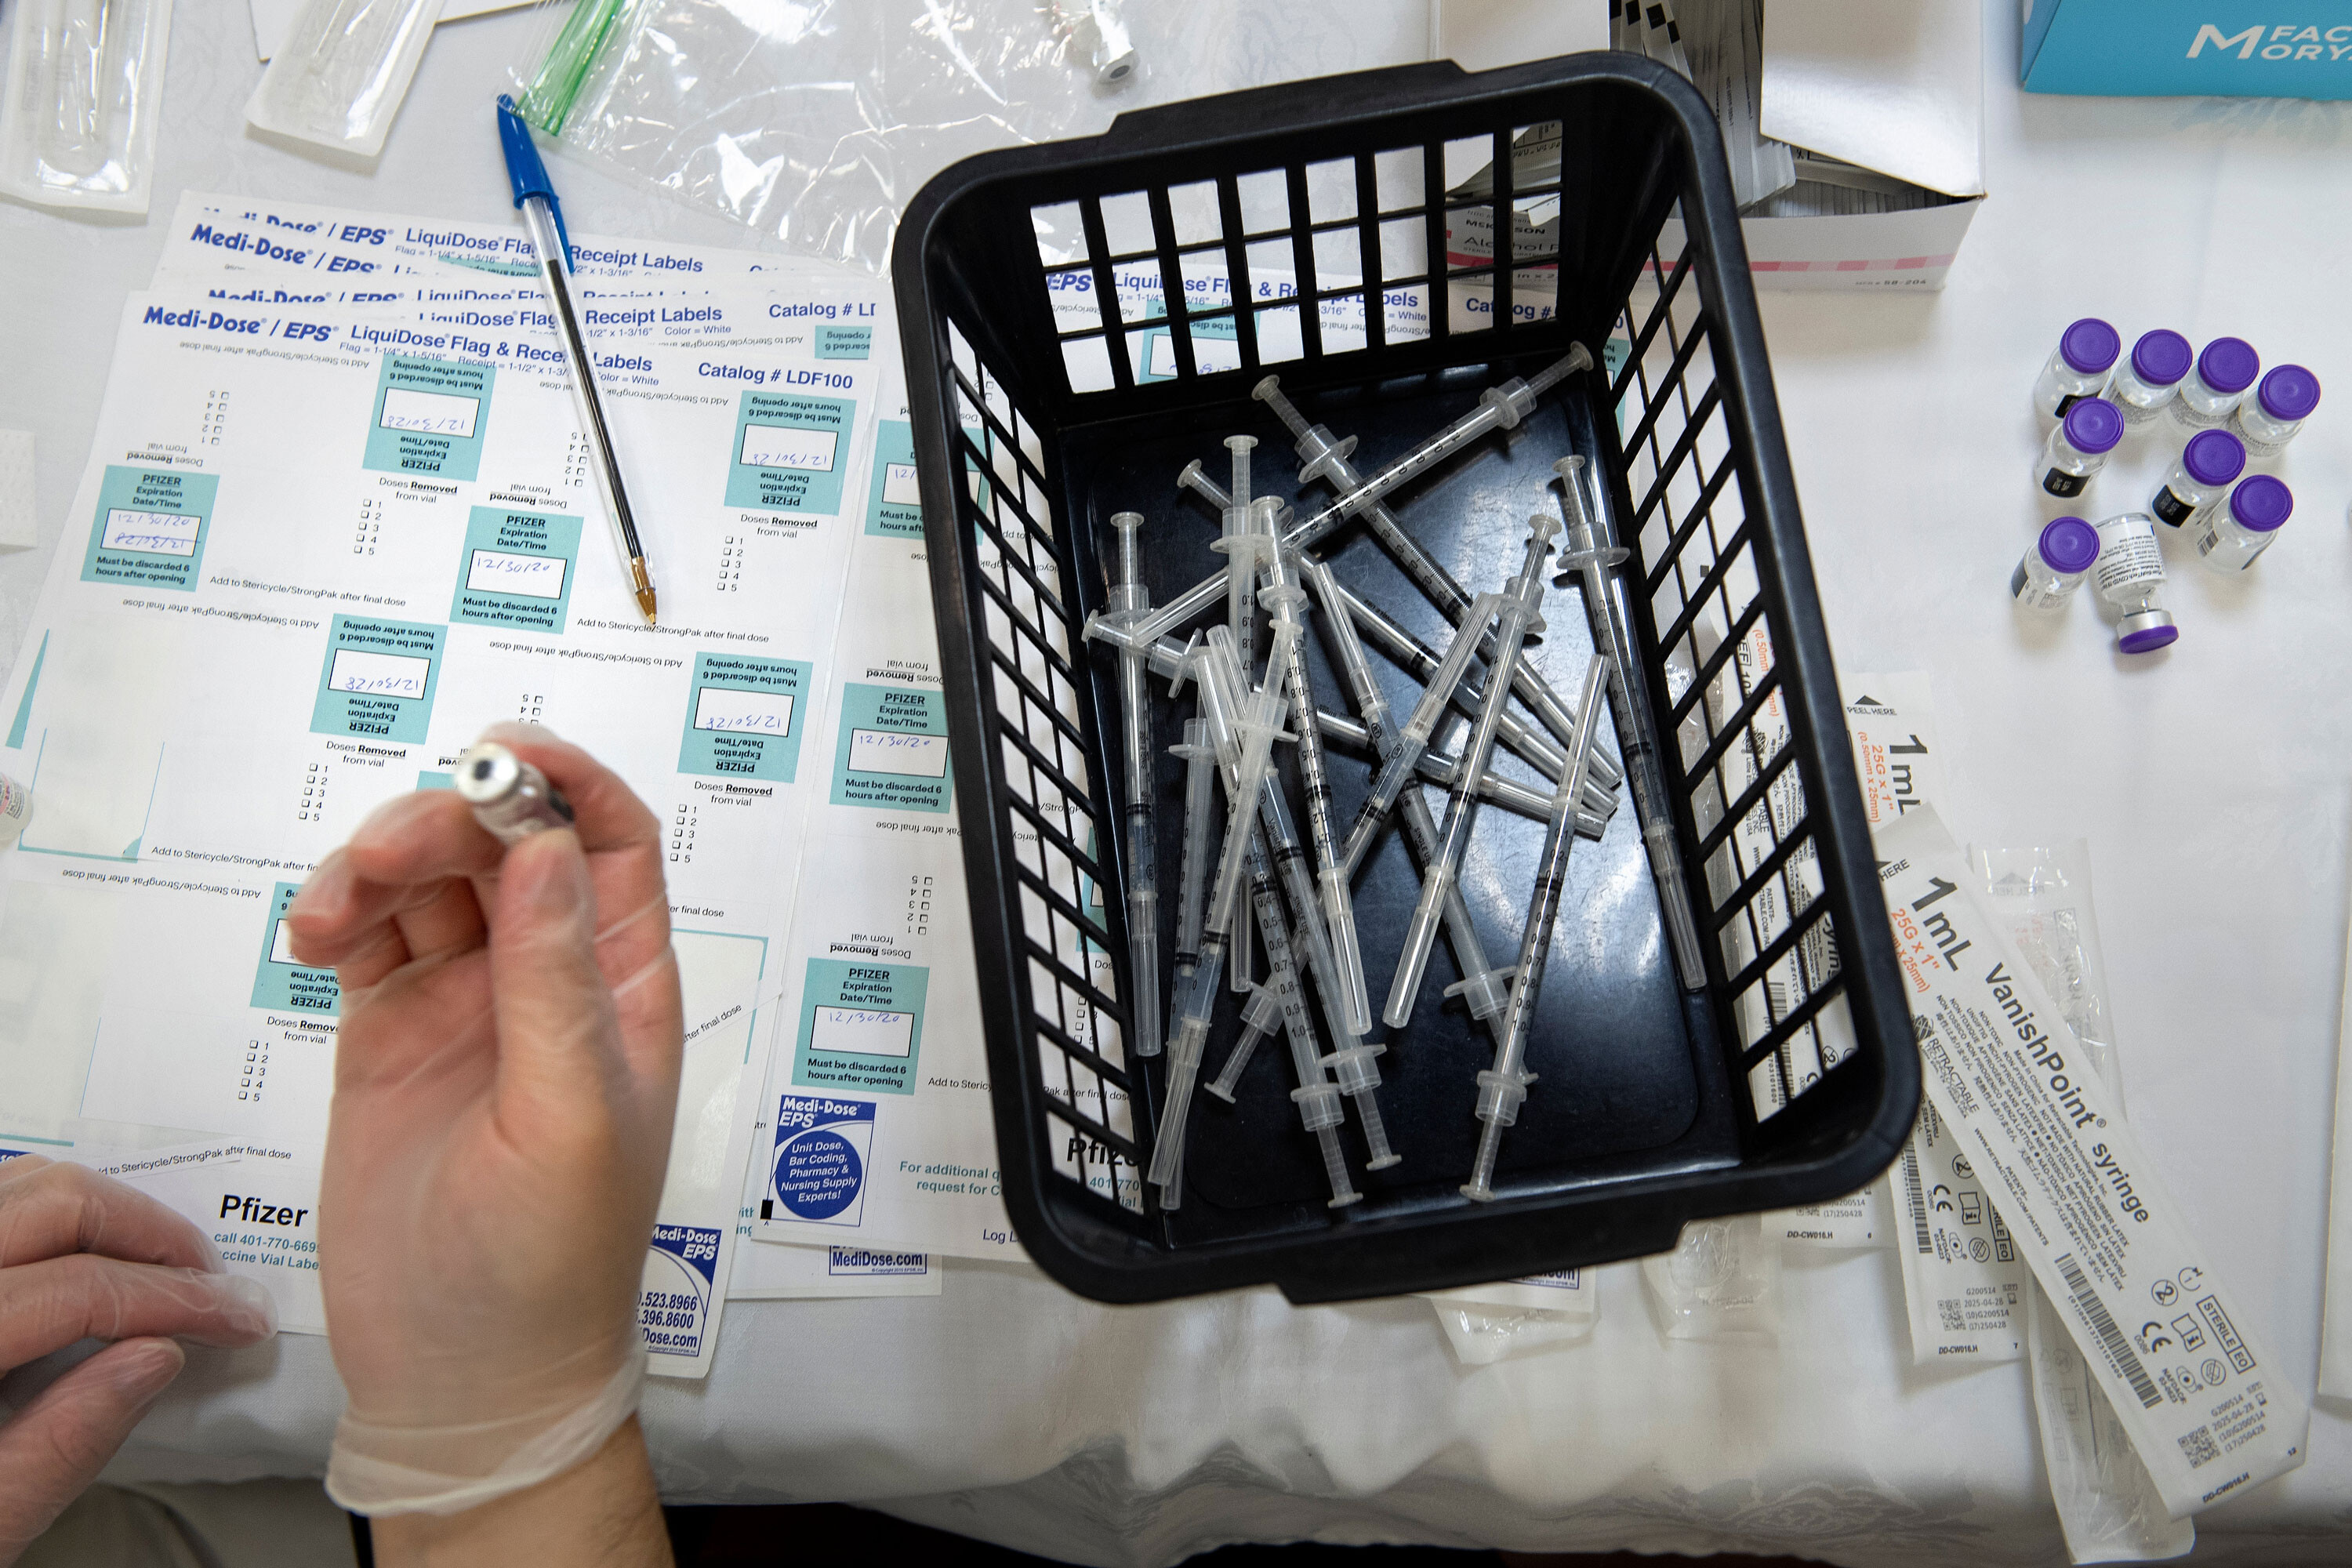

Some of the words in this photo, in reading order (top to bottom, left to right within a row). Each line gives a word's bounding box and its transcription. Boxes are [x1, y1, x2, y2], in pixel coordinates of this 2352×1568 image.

[2270, 25, 2352, 42] FAC
[2261, 44, 2352, 60] ORY
[571, 245, 639, 267] Receipt
[643, 252, 702, 272] Labels
[1047, 274, 1092, 292] EPS
[585, 309, 655, 326] Receipt
[661, 307, 722, 321] Labels
[769, 302, 836, 319] Catalog
[1398, 310, 1427, 321] White
[450, 336, 490, 358] Flag
[516, 343, 568, 364] Rece
[593, 351, 652, 371] Labels
[698, 362, 765, 384] Catalog
[786, 369, 852, 388] LDF100
[142, 474, 182, 487] PFIZER
[379, 477, 408, 488] Doses
[410, 481, 457, 494] Removed
[136, 485, 182, 497] Expiration
[395, 491, 418, 500] from
[132, 496, 182, 508] Date/Time
[375, 512, 381, 521] 2
[506, 515, 546, 527] PFIZER
[499, 527, 547, 539] Expiration
[496, 537, 546, 550] Date/Time
[96, 556, 120, 564] Must
[121, 557, 133, 567] be
[135, 560, 182, 571] discarded
[96, 567, 122, 576] hours
[123, 570, 147, 579] after
[147, 573, 186, 585] opening
[209, 576, 229, 585] Add
[241, 579, 336, 598] Stericycle/StrongPak
[339, 592, 360, 601] after
[363, 594, 382, 604] final
[383, 597, 405, 606] dose
[463, 597, 486, 607] Must
[488, 599, 500, 608] be
[502, 601, 550, 613] discarded
[462, 608, 488, 618] hours
[490, 612, 514, 620] after
[515, 615, 553, 627] opening
[884, 692, 924, 705] PFIZER
[879, 705, 927, 717] Expiration
[349, 721, 389, 734] PFIZER
[876, 716, 927, 728] Date/Time
[1857, 731, 1872, 775] (0.50mm
[1867, 786, 1881, 822] 25mm)
[1872, 745, 1886, 775] 25G
[1882, 794, 1893, 809] 1"
[1879, 859, 1910, 882] HERE
[1258, 897, 1272, 908] 0.4
[1263, 919, 1278, 930] 0.5
[1269, 940, 1283, 951] 0.6
[1890, 909, 1918, 939] 25G
[1922, 954, 1940, 968] 1"
[1274, 960, 1289, 973] 0.7
[1279, 982, 1294, 995] 0.8
[1285, 1004, 1300, 1016] 0.9
[1291, 1025, 1306, 1038] 1.0
[1929, 1037, 1979, 1112] RETRACTABLE
[1966, 1007, 1987, 1039] UNGIFTIG
[1987, 1042, 2024, 1097] NICHT-PYROGEN
[2021, 1098, 2048, 1134] LATEXFREI
[2048, 1141, 2059, 1152] NO
[2100, 1223, 2111, 1236] SIN
[1978, 1011, 2003, 1047] NON-TOXIC
[2002, 1051, 2040, 1105] NON-PYROGENIC
[2039, 1109, 2053, 1123] NOT
[2049, 1123, 2065, 1145] MADE
[2062, 1144, 2076, 1163] WITH
[2073, 1163, 2095, 1195] NATURAL
[2092, 1195, 2114, 1225] RUBBER
[2111, 1224, 2129, 1247] LATEX
[2013, 1049, 2027, 1067] Made
[2029, 1074, 2043, 1094] China
[2041, 1093, 2050, 1103] for
[2048, 1103, 2073, 1139] Retractable
[2071, 1139, 2099, 1184] Technologies,
[2098, 1183, 2107, 1196] Inc.
[792, 1142, 812, 1153] Unit
[815, 1142, 844, 1151] Dose,
[789, 1156, 807, 1166] Bar
[809, 1152, 847, 1163] Coding,
[789, 1167, 839, 1178] Pharmacy
[899, 1160, 921, 1173] For
[924, 1163, 988, 1178] additional
[781, 1179, 820, 1191] Nursing
[822, 1176, 857, 1189] Supply
[916, 1181, 964, 1193] request
[969, 1183, 987, 1195] for
[2092, 1142, 2149, 1223] syringe
[797, 1189, 841, 1203] Experts!
[220, 1194, 308, 1227] Pfizer
[214, 1232, 237, 1243] call
[983, 1229, 1005, 1243] Log
[220, 1250, 256, 1262] ccine
[261, 1253, 285, 1265] Vial
[288, 1259, 321, 1270] Labe
[832, 1252, 922, 1266] MediDose.com
[637, 1293, 697, 1310] .523.8966
[636, 1310, 694, 1329] .396.8600
[642, 1328, 697, 1347] Dose.com
[2133, 1334, 2151, 1355] 0086
